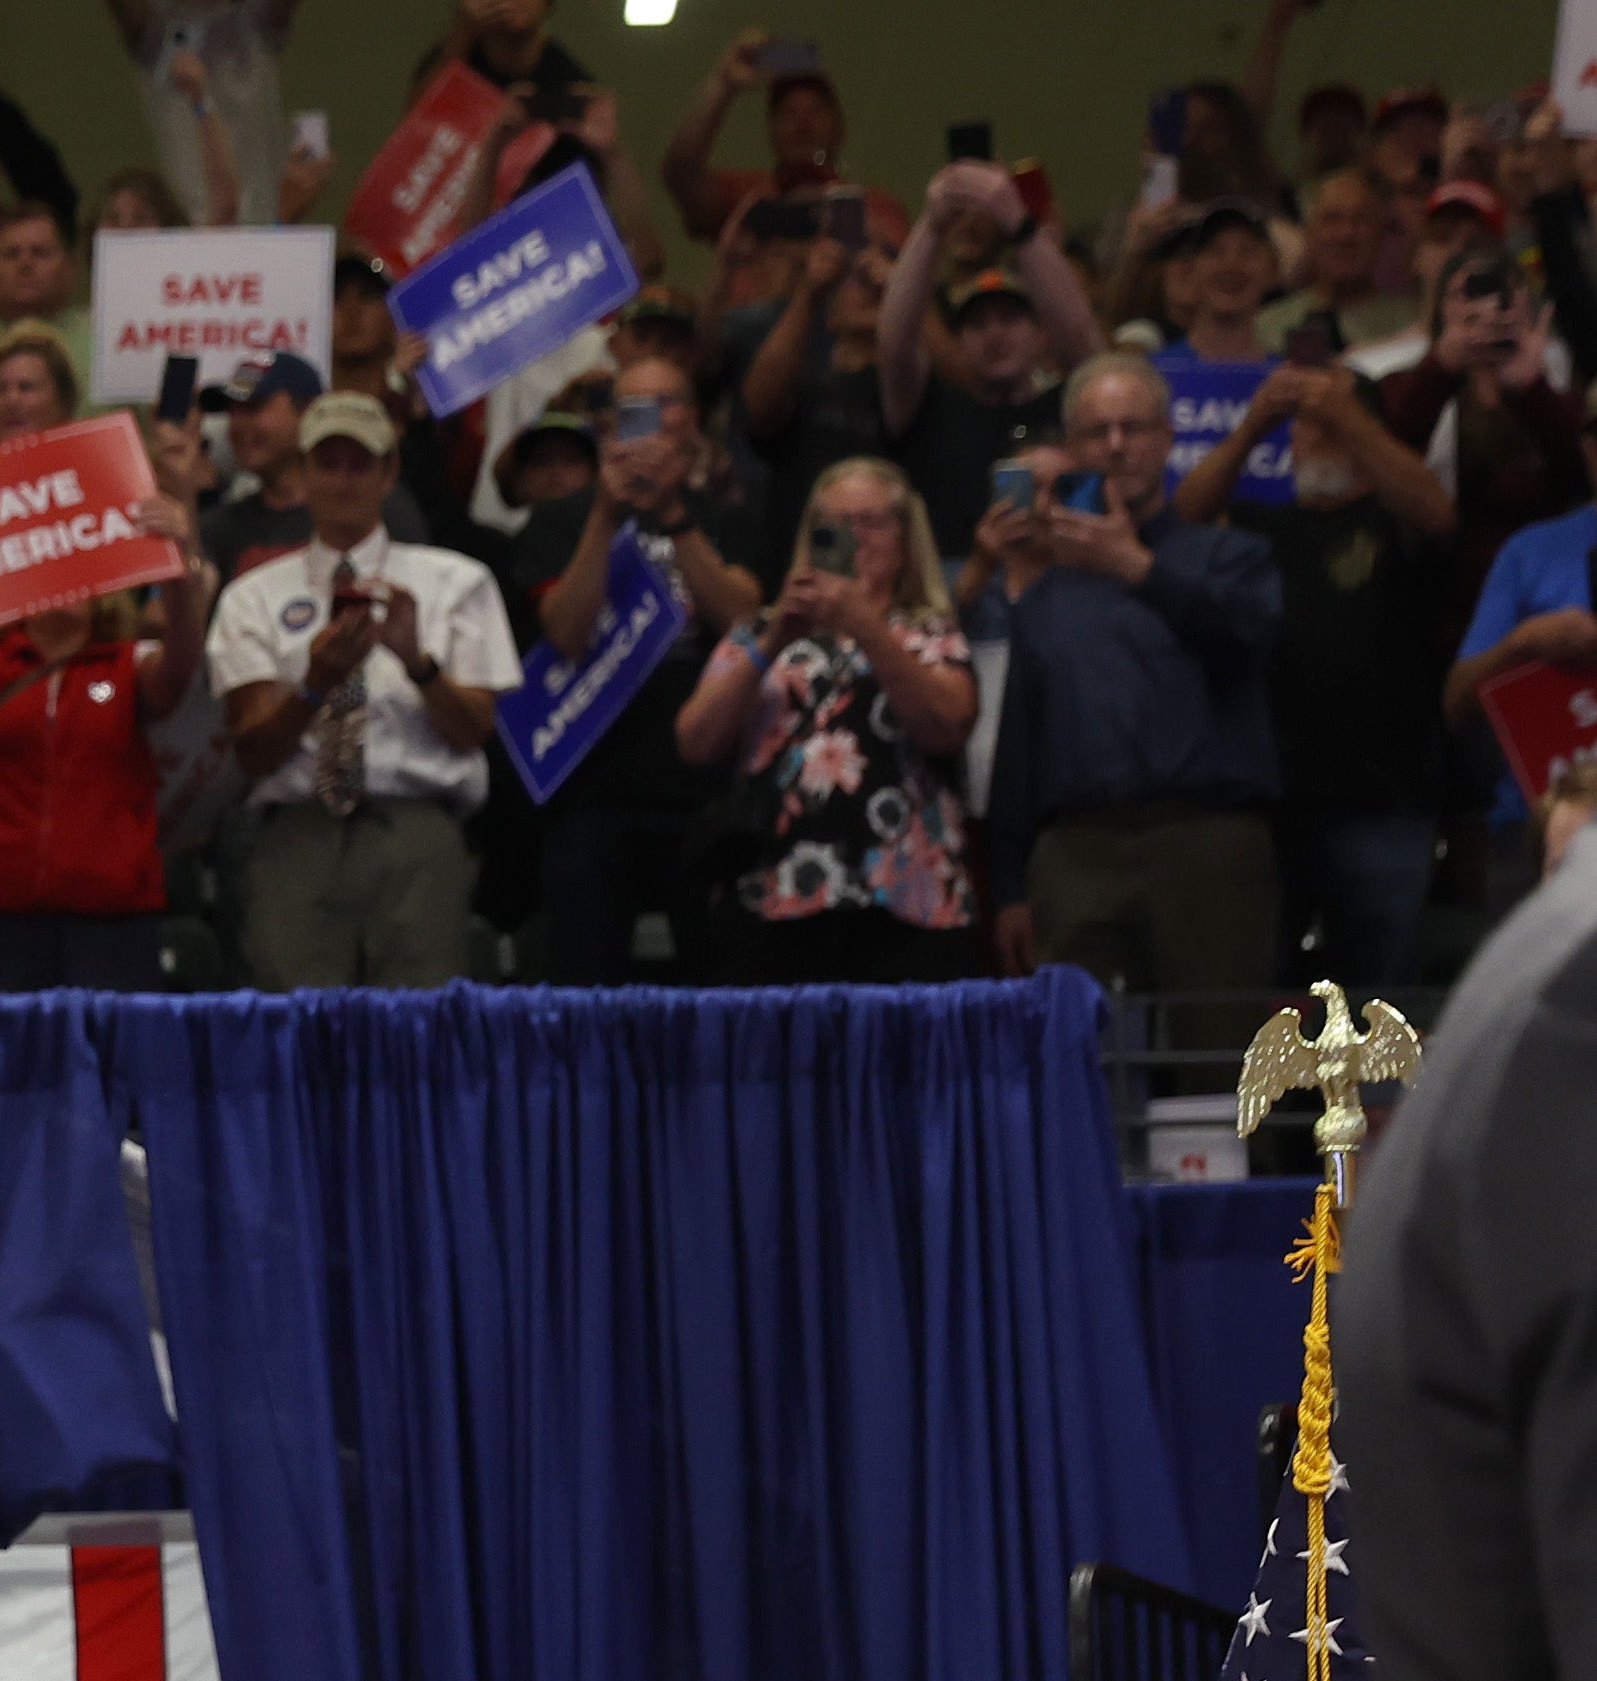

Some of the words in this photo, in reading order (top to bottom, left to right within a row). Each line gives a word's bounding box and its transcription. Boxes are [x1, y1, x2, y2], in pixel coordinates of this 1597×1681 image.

[450, 229, 551, 310] SAVE
[163, 270, 264, 307] SAVE
[431, 239, 608, 373] AMERICA!
[116, 316, 309, 352] AMERICA!
[1171, 397, 1253, 434] SAV
